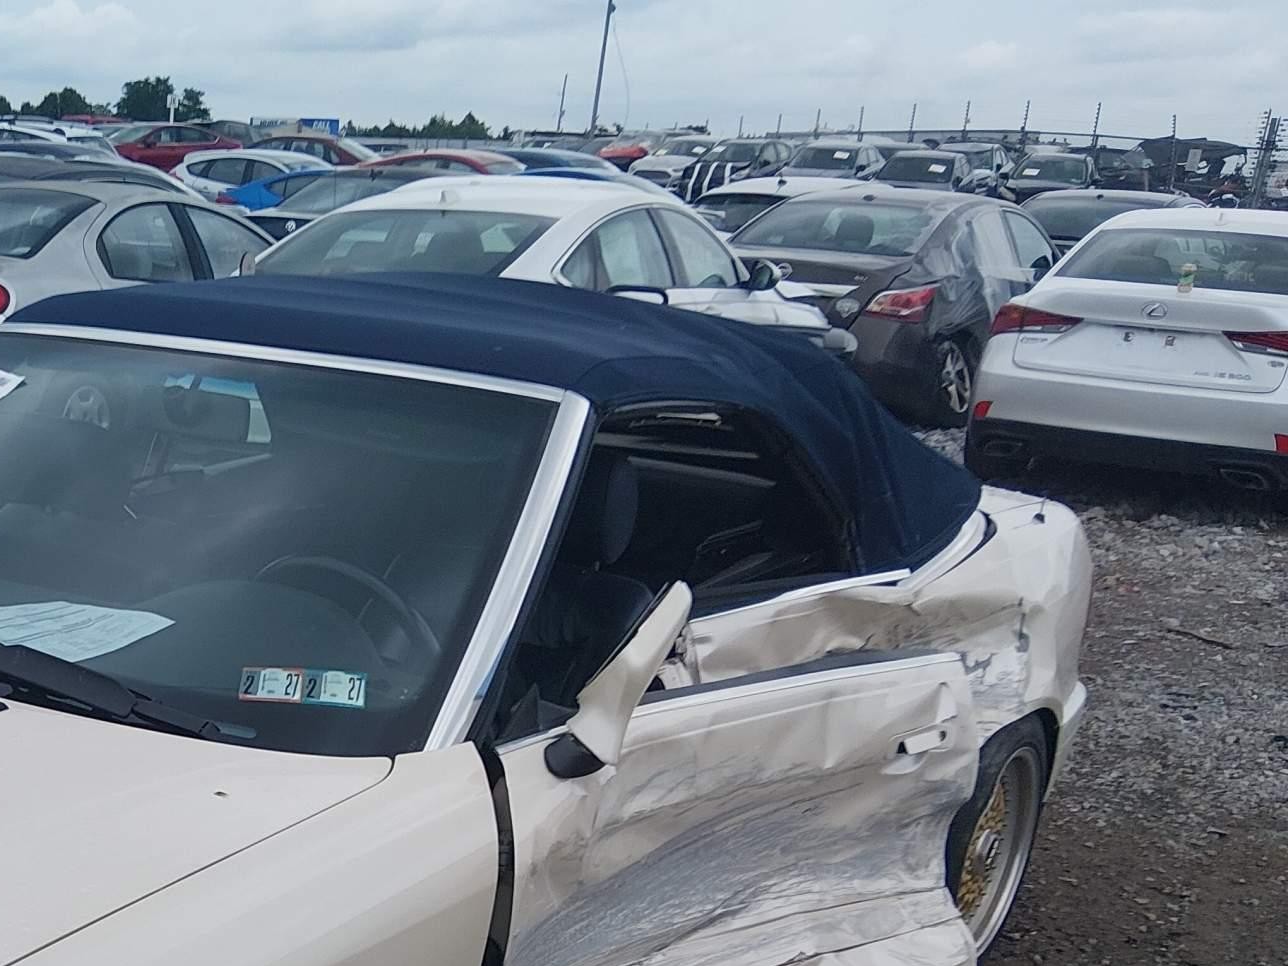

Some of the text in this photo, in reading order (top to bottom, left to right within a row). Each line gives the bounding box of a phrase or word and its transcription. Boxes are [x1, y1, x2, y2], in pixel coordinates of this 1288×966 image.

[243, 675, 255, 695] 2
[284, 673, 300, 698] 27
[306, 678, 317, 698] 2
[348, 677, 362, 702] 27
